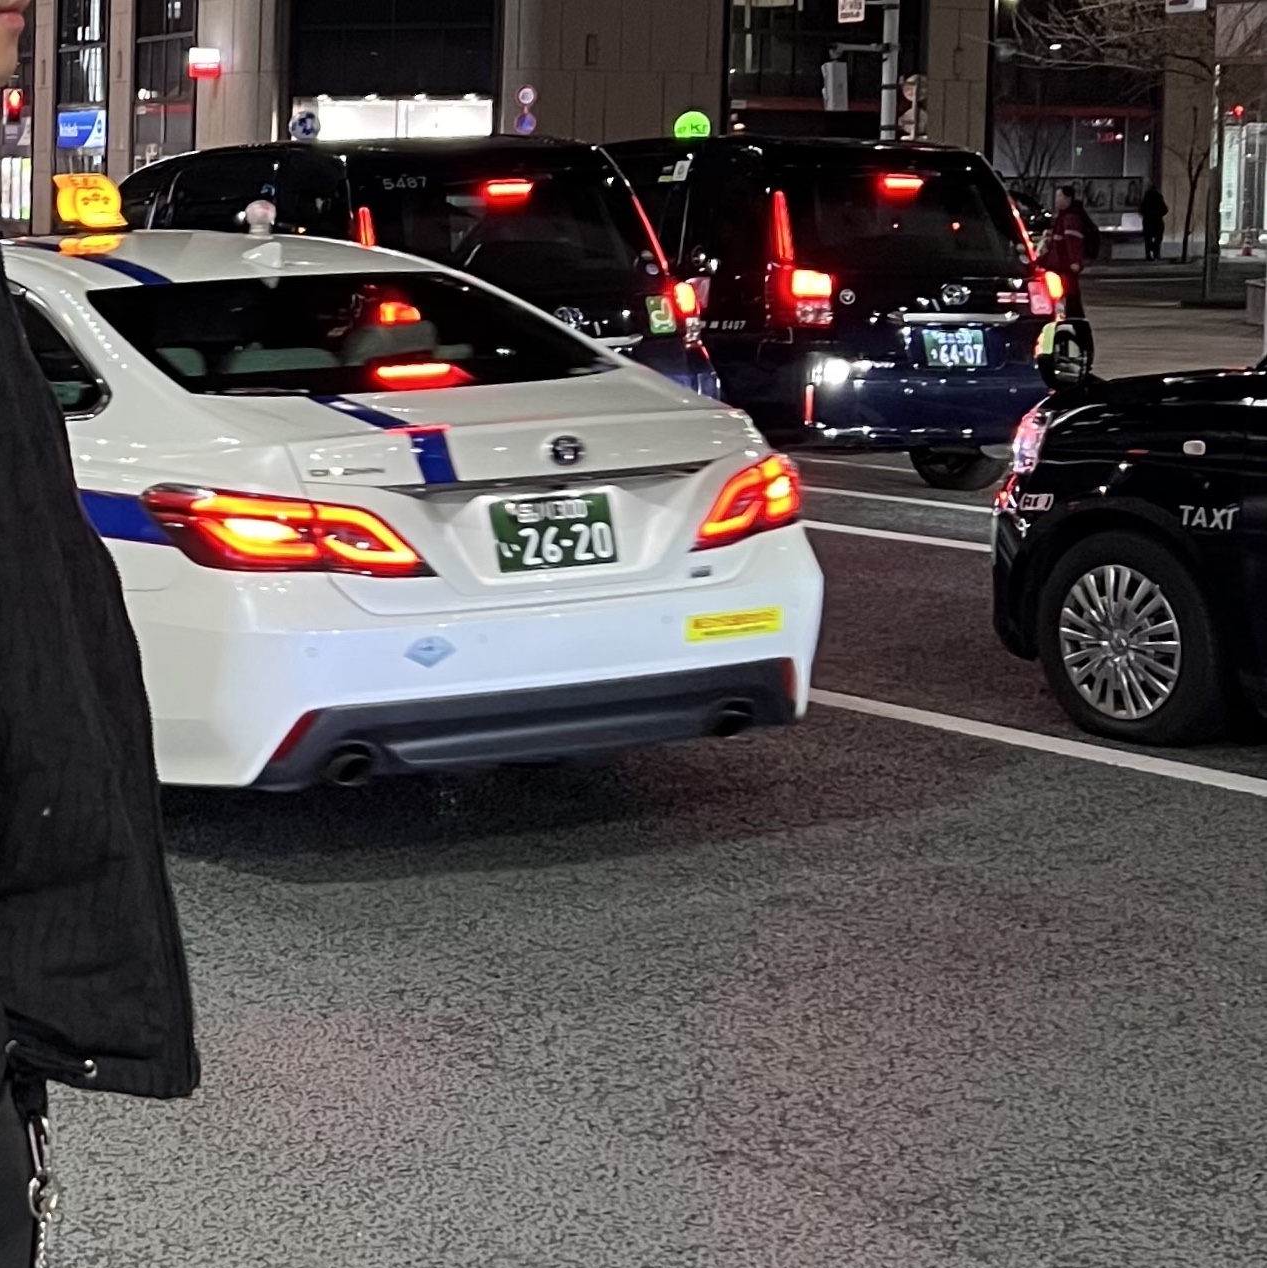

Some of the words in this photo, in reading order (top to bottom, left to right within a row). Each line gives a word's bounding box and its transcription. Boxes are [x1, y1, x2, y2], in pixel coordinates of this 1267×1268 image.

[383, 176, 427, 190] 5487
[939, 344, 984, 365] 64-07
[1179, 504, 1240, 530] TAXI
[517, 522, 615, 566] 26-20
